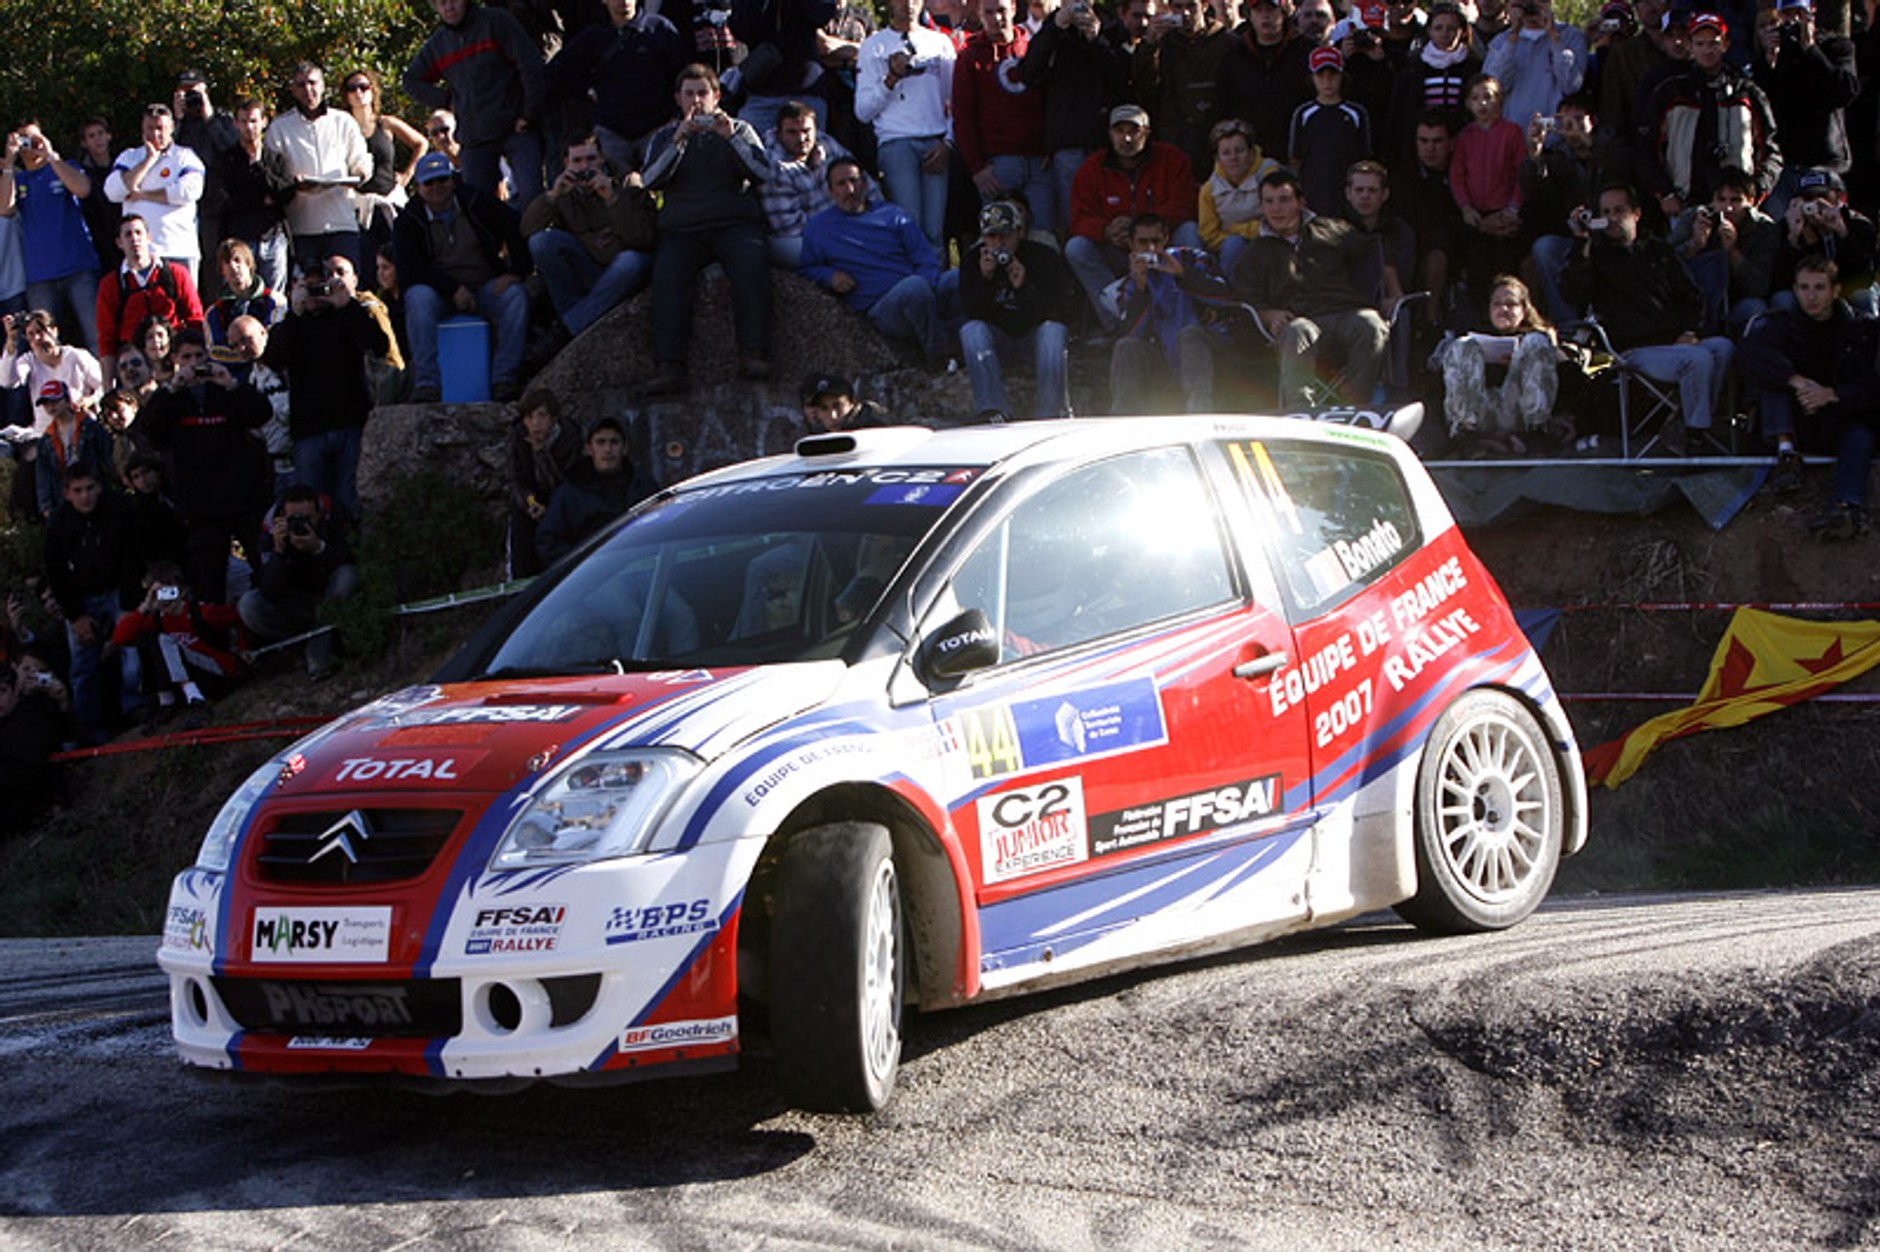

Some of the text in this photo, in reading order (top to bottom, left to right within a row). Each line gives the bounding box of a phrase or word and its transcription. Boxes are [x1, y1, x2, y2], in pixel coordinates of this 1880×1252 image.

[1336, 518, 1402, 578] Bonato
[938, 628, 996, 652] TOTAL
[1269, 557, 1468, 718] ÉQUIPE DE FRANCE
[1314, 608, 1480, 748] 2007 RALLYE
[966, 706, 1017, 777] 44
[335, 757, 457, 781] TOTAL
[992, 784, 1071, 828] C2
[996, 811, 1071, 864] JUNIOR
[995, 844, 1075, 873] EXPERIENCE
[641, 899, 710, 929] BPS
[256, 915, 339, 955] MARSY
[493, 937, 555, 952] RALLYE
[625, 1021, 732, 1045] BFGoodrich
